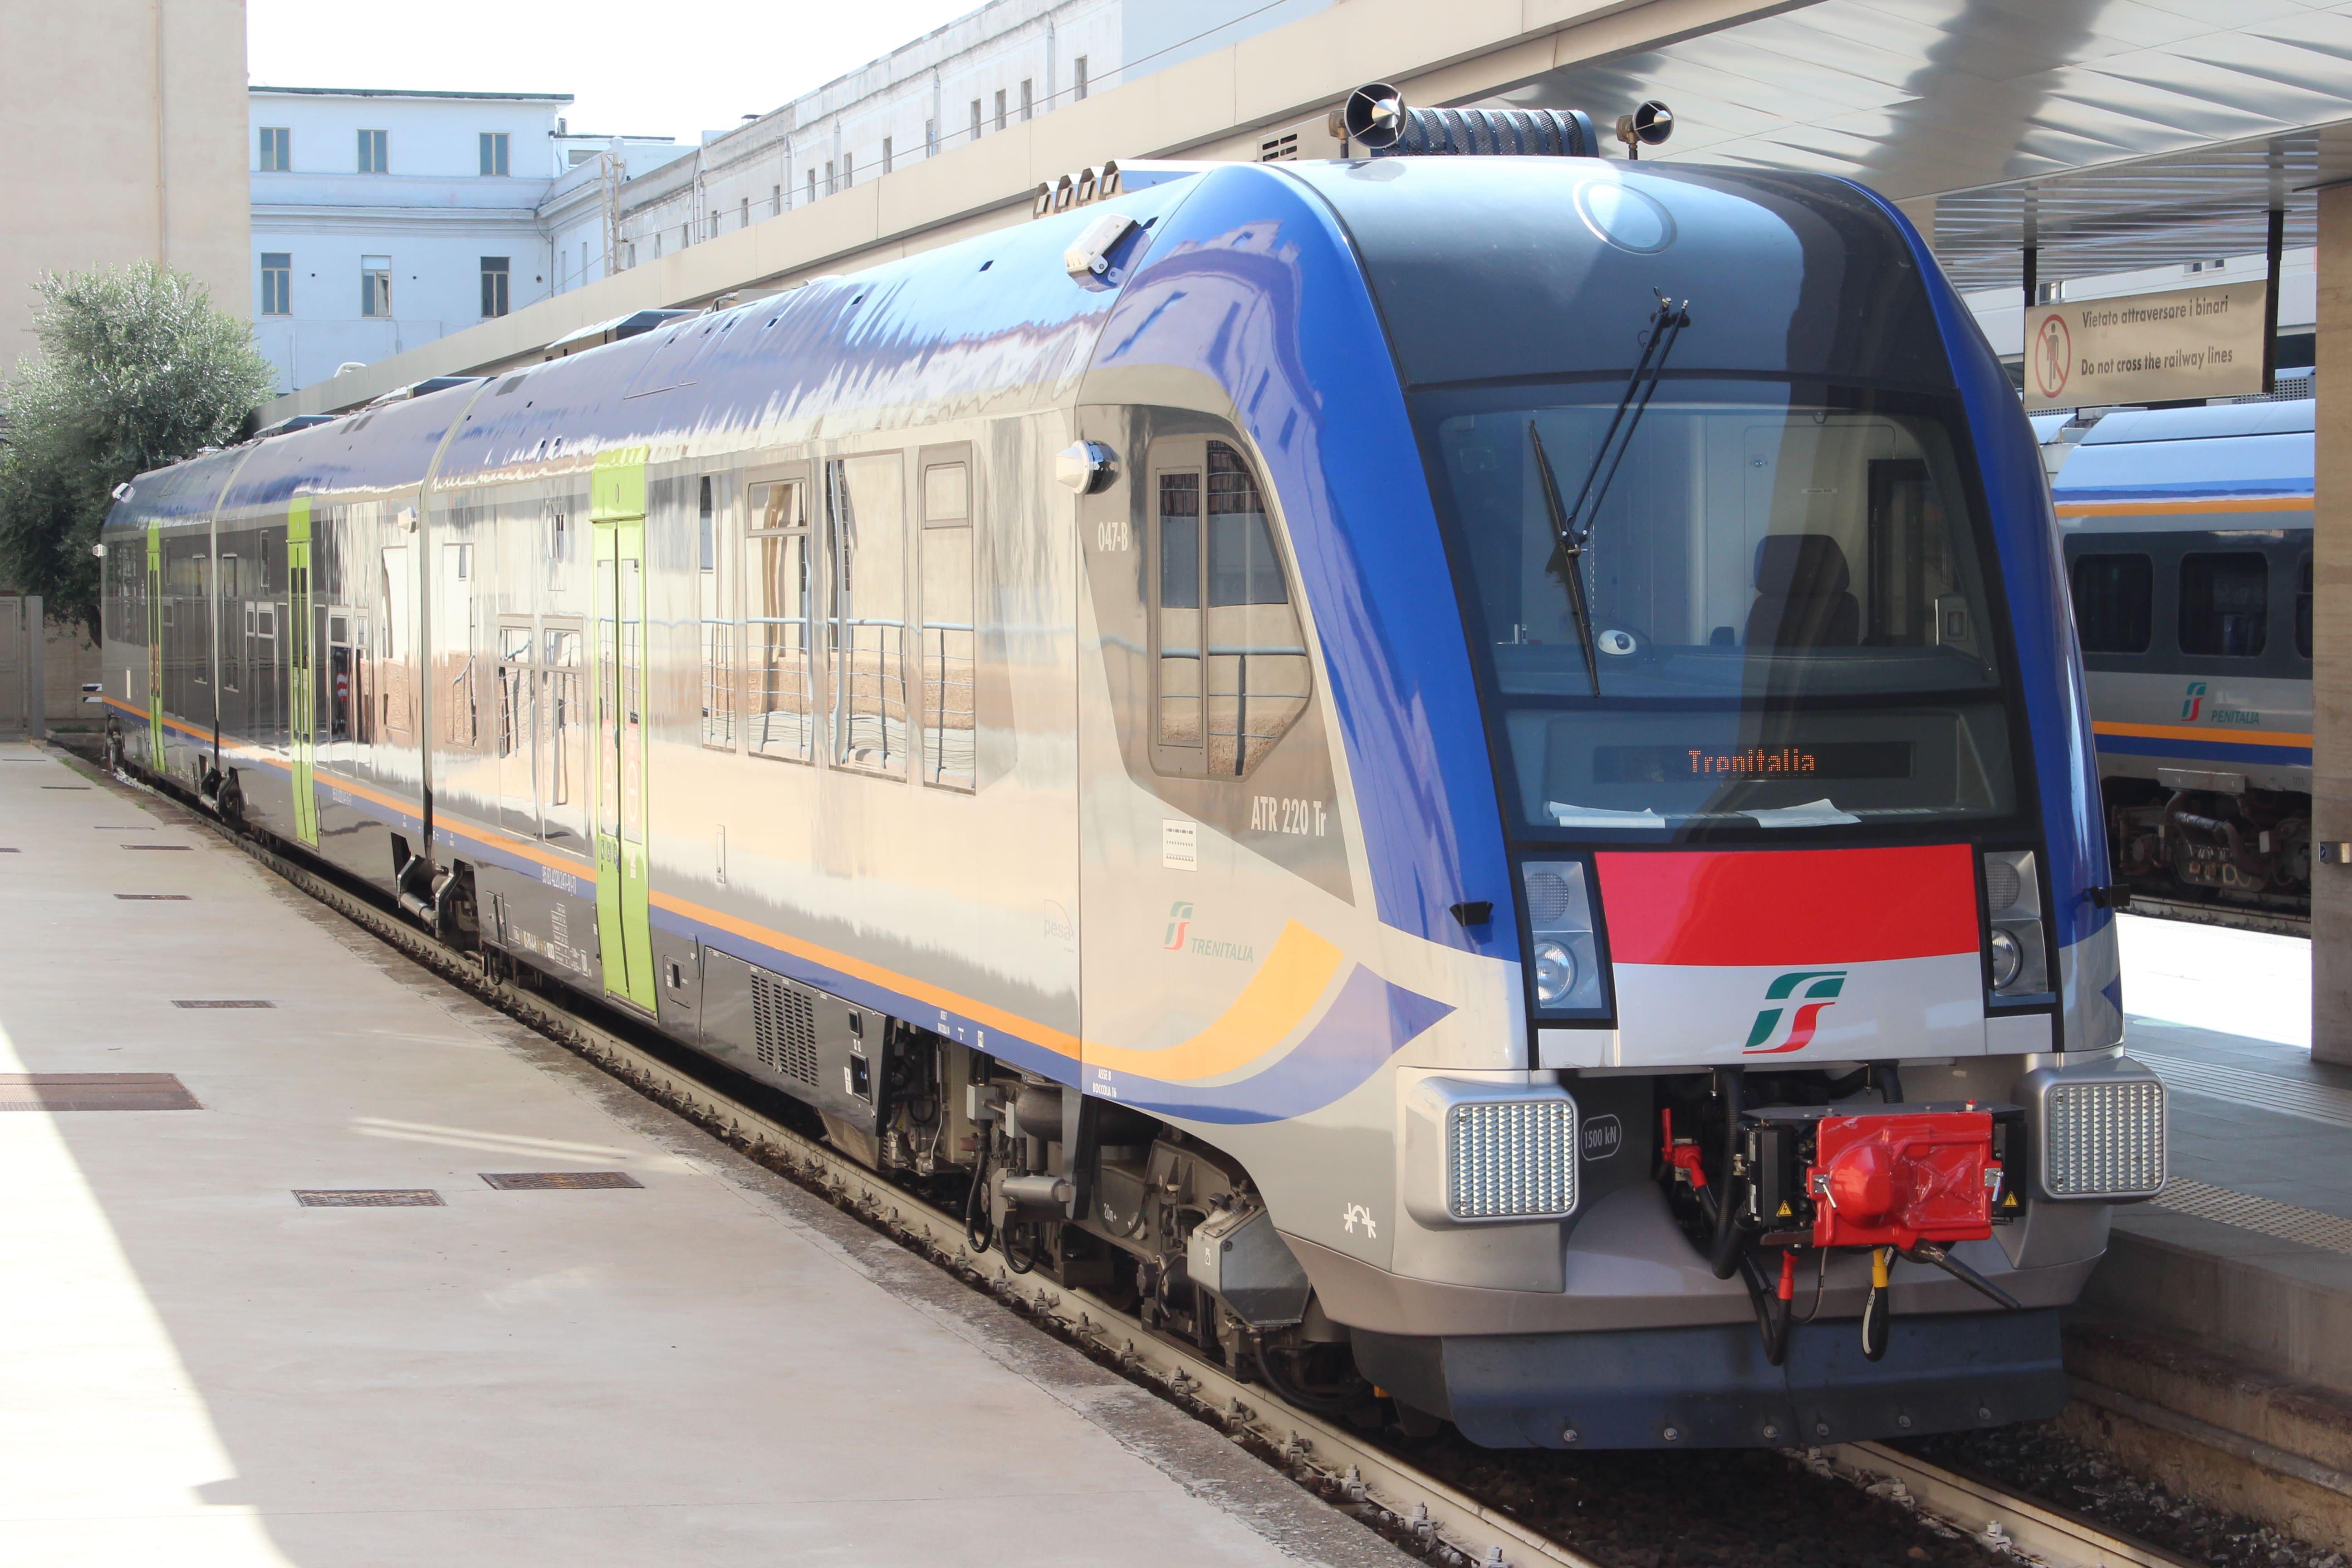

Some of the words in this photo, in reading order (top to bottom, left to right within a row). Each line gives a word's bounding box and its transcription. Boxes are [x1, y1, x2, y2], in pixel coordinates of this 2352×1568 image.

[2082, 311, 2118, 328] Vietato
[2121, 305, 2186, 324] attraversare
[2190, 299, 2193, 317] i
[2196, 295, 2228, 316] binari
[2081, 359, 2095, 376] Do
[2097, 358, 2114, 374] not
[2117, 358, 2142, 373] cross
[2144, 352, 2161, 370] the
[2164, 348, 2205, 370] railway
[2208, 345, 2233, 364] lines
[1098, 522, 1128, 552] 047-B
[1688, 748, 1815, 773] Trenitalia
[1251, 795, 1278, 832] ATR
[1282, 798, 1308, 835] 220
[1313, 800, 1327, 837] Tr
[1044, 919, 1071, 941] pesa
[1191, 937, 1254, 962] TRENITALIA
[1098, 1068, 1107, 1081] ASSE
[1108, 1070, 1111, 1082] 8
[1093, 1082, 1111, 1097] BOCCOLA
[1112, 1087, 1117, 1098] 16
[1584, 1128, 1602, 1149] 1500
[1605, 1126, 1617, 1145] kN
